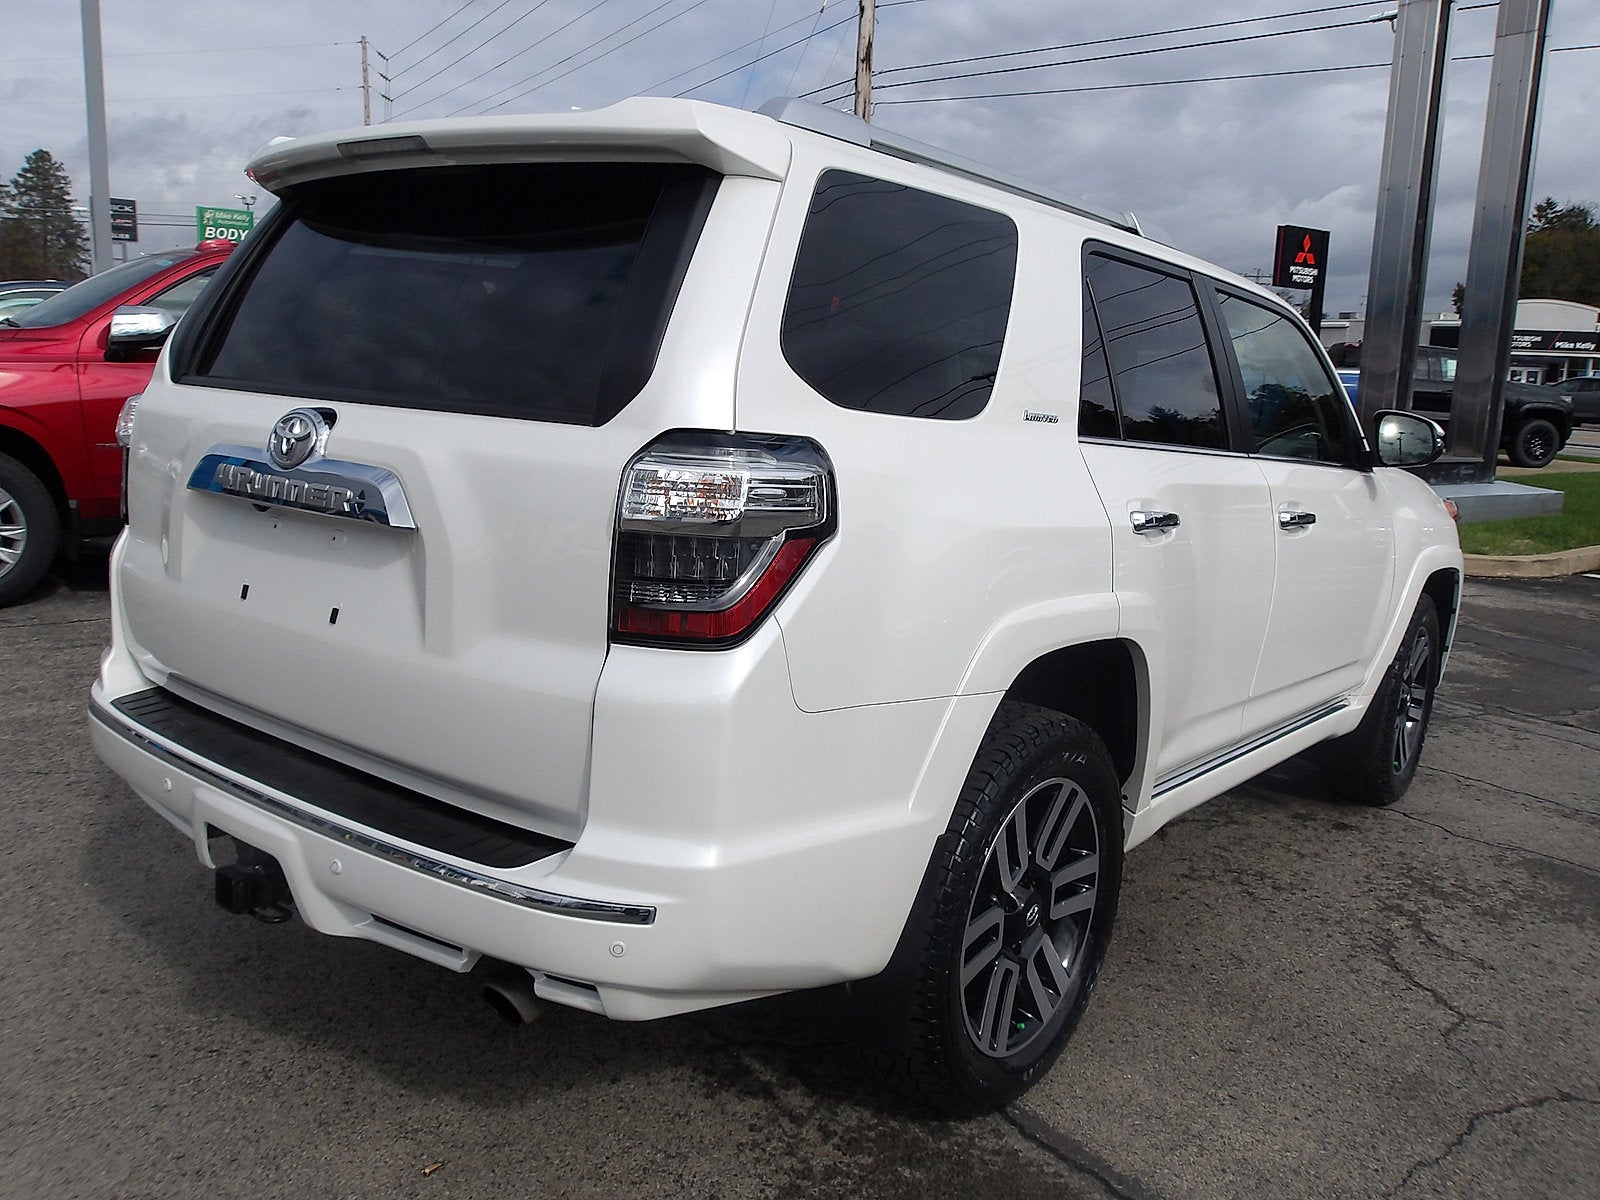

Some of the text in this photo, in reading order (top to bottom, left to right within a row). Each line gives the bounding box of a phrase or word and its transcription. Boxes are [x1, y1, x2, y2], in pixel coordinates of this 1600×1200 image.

[215, 211, 250, 222] Mike Kelly
[204, 226, 250, 241] BODY
[1289, 265, 1319, 276] MITSUBISHI
[1292, 274, 1314, 284] MOTORS
[1554, 341, 1597, 351] Mike Kelly
[215, 463, 355, 513] 4RUNNER
